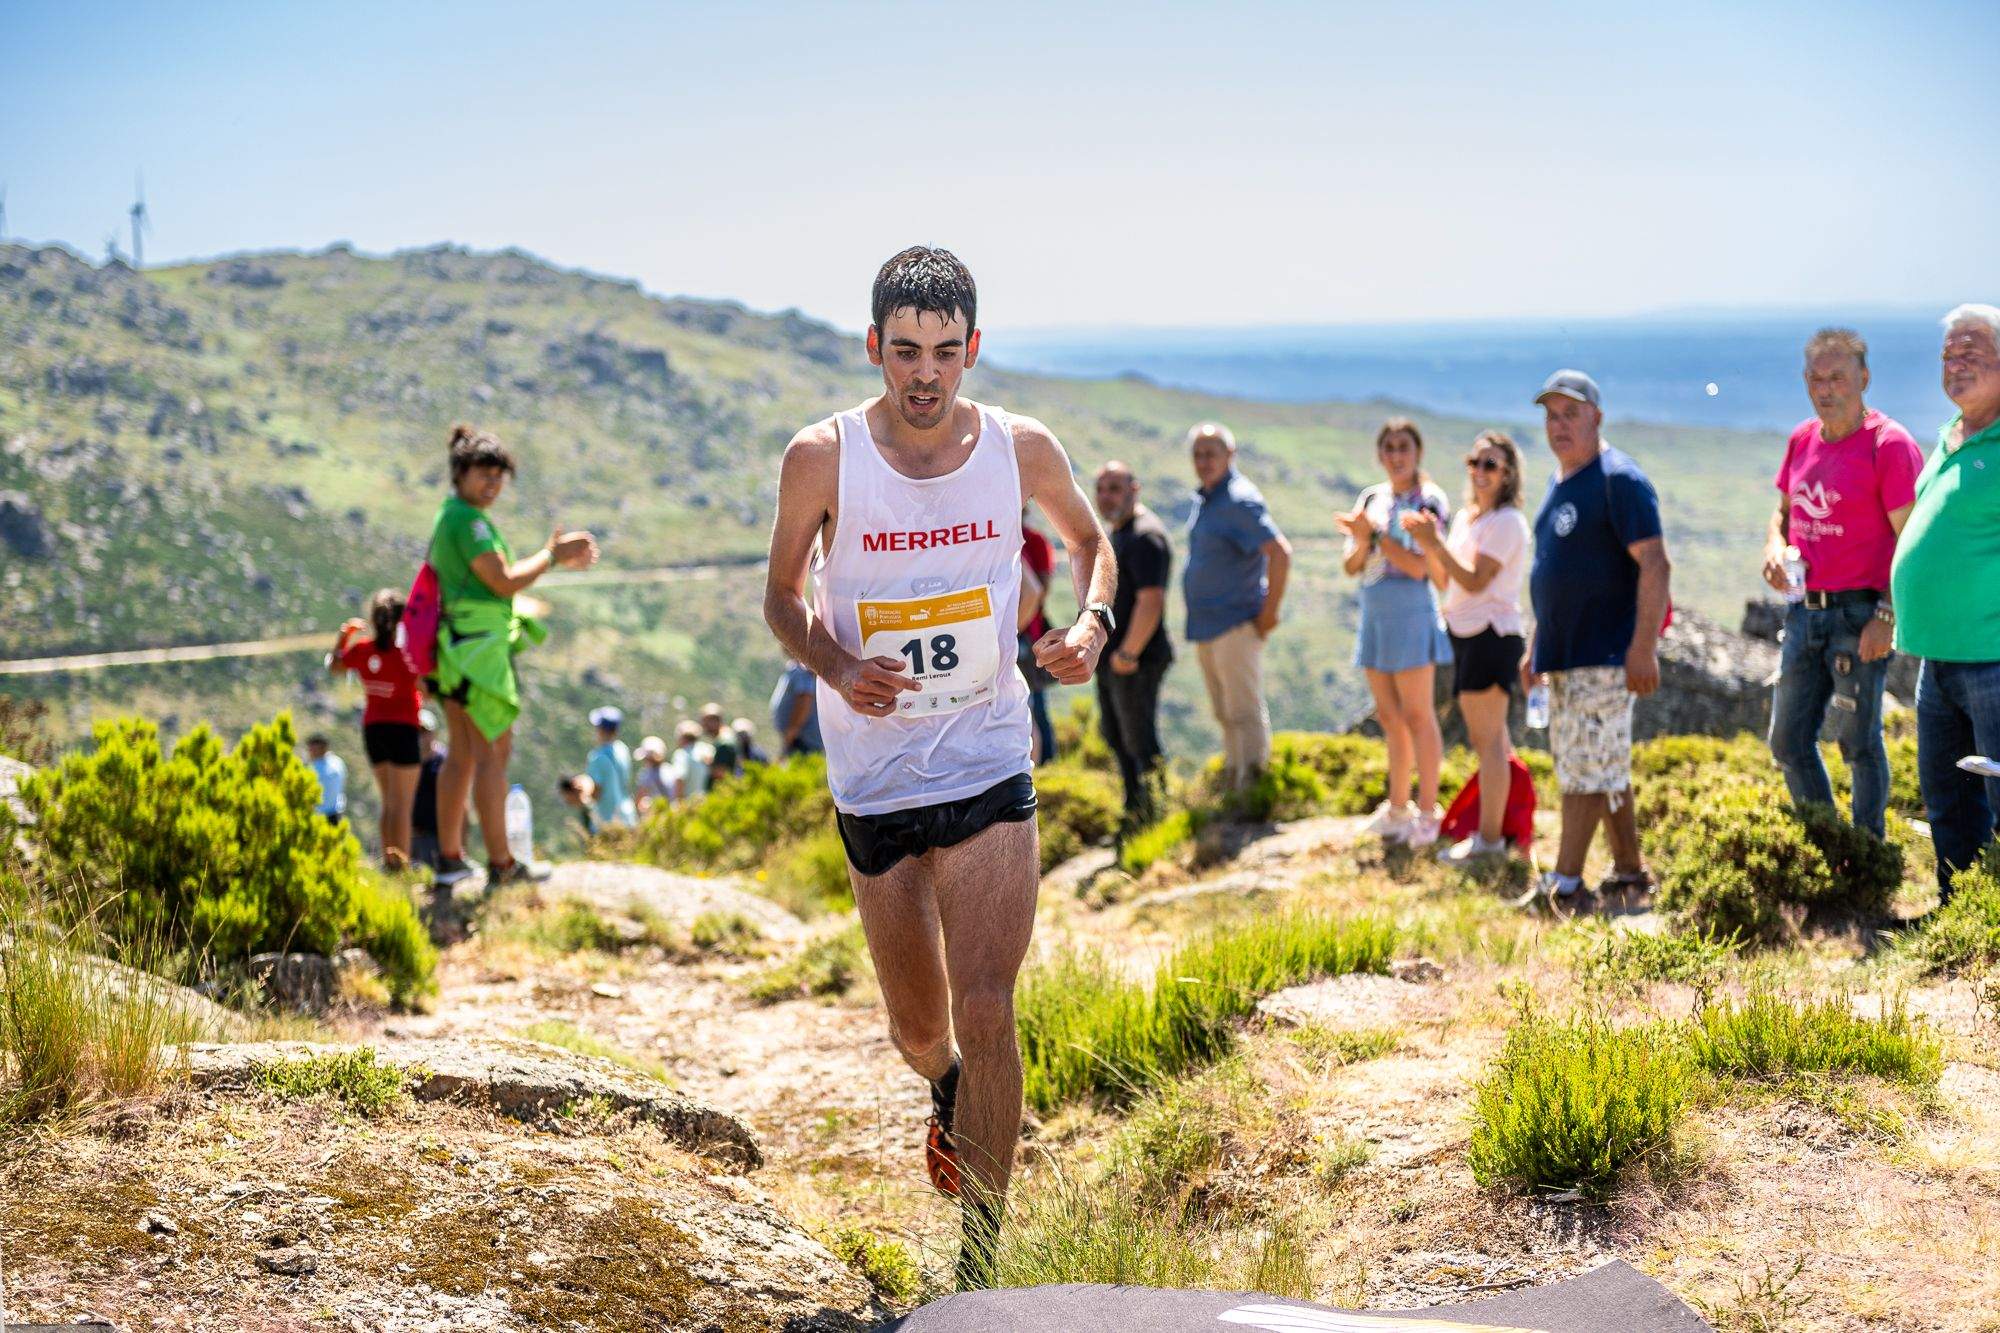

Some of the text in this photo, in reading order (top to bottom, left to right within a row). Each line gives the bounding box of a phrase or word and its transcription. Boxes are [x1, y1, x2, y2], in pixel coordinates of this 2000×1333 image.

[863, 520, 1000, 552] MERRELL
[901, 633, 959, 675] 18
[929, 672, 951, 680] Leroux
